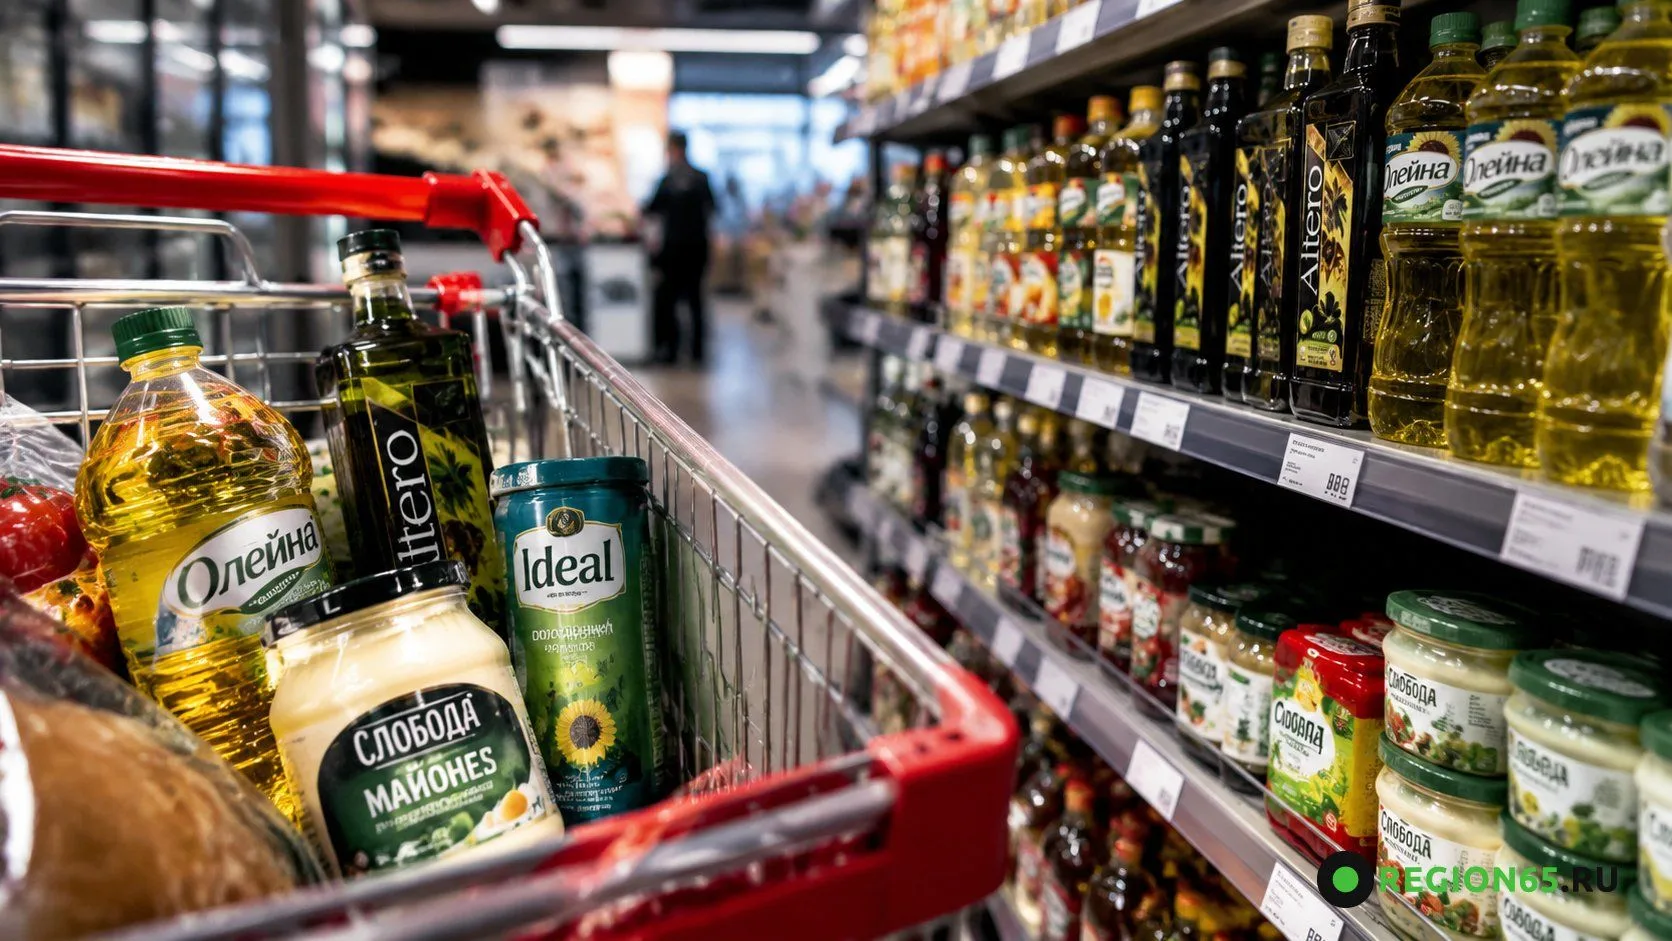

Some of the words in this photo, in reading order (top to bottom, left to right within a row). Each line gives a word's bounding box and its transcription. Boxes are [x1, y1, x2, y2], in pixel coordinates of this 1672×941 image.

[1230, 183, 1247, 291] Altero
[1300, 165, 1323, 296] Altero
[386, 429, 440, 568] ltero
[178, 520, 319, 609] Олейна
[522, 539, 615, 592] Ideal
[354, 697, 482, 767] СЛОБОДА
